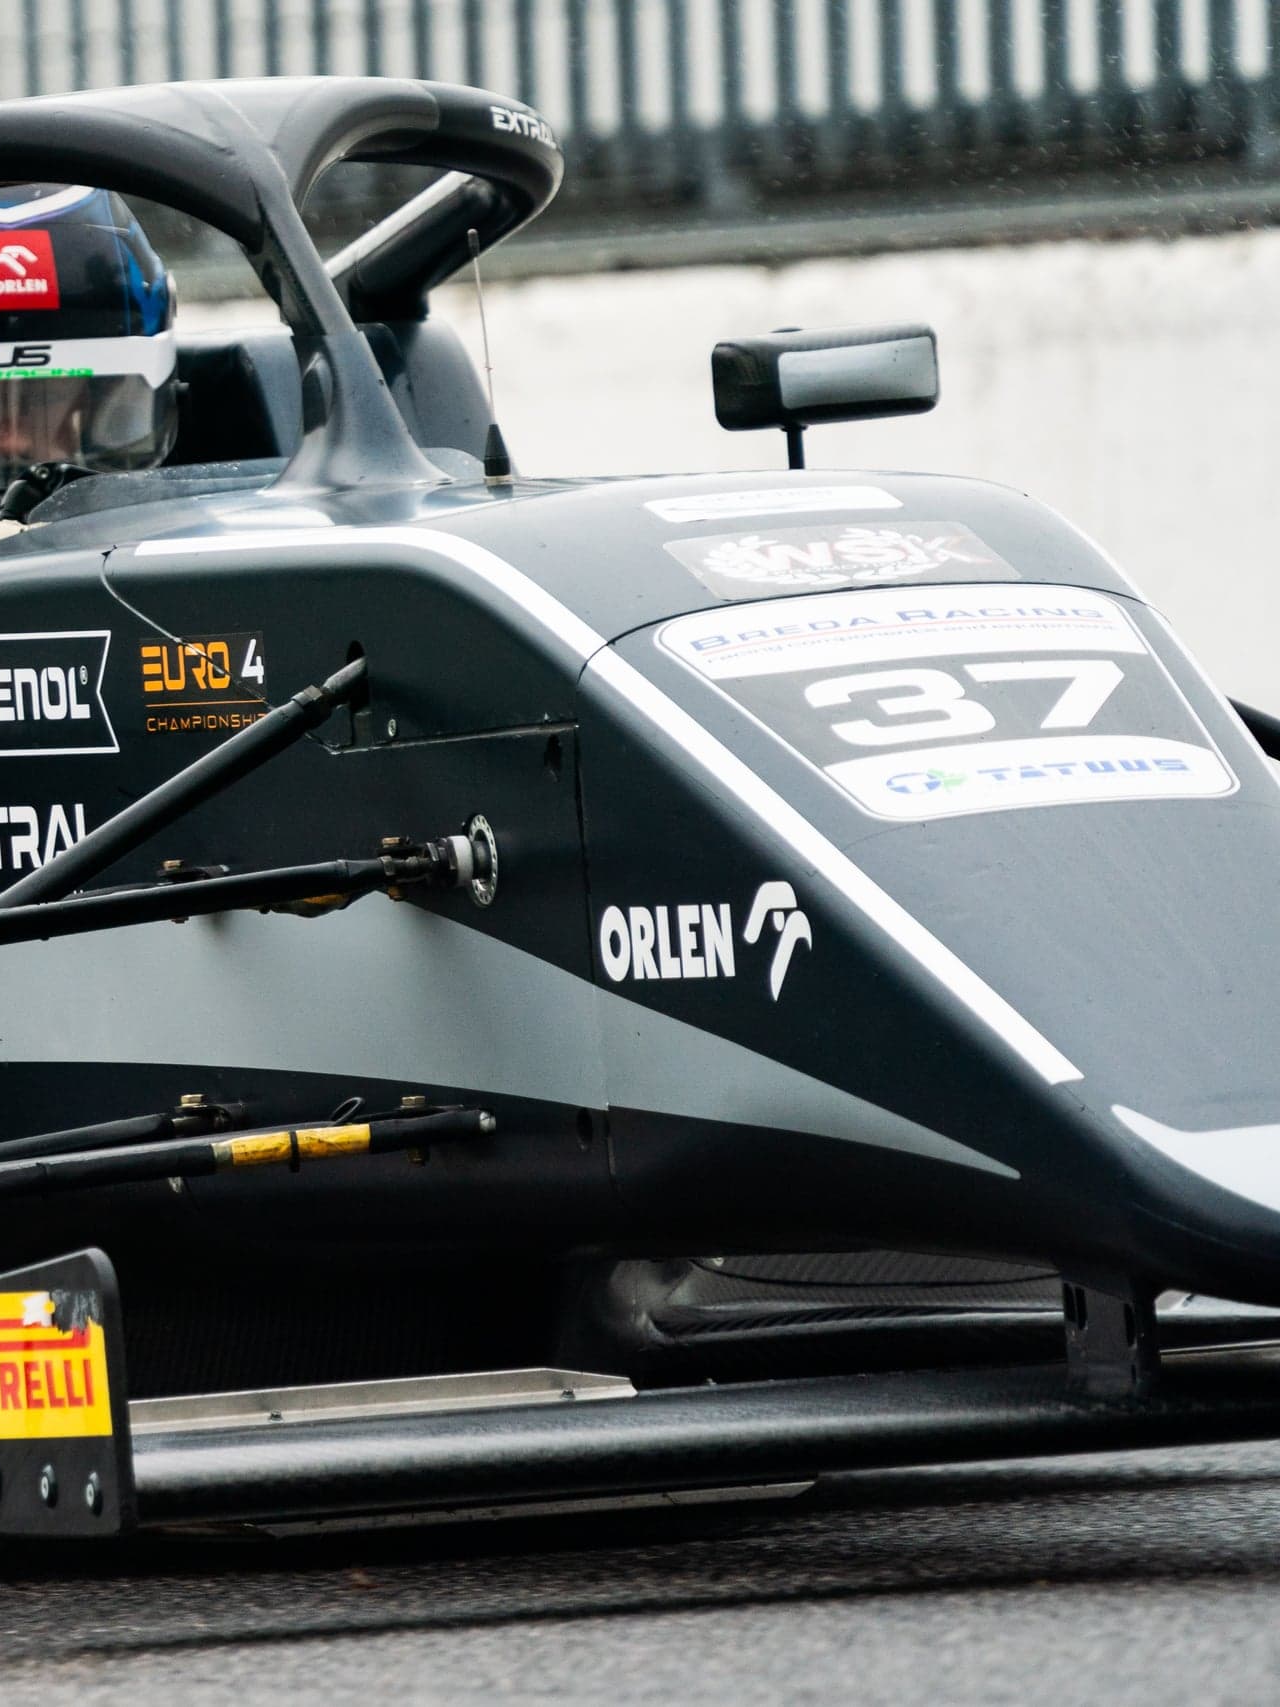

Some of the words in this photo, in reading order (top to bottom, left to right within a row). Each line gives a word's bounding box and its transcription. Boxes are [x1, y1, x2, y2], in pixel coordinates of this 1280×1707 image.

[689, 617, 879, 651] BREDA
[895, 607, 1105, 621] RACING
[141, 641, 231, 692] EURO
[241, 638, 265, 684] 4
[803, 660, 1125, 746] 37
[977, 758, 1190, 782] TATUUS
[600, 902, 736, 983] ORLEN
